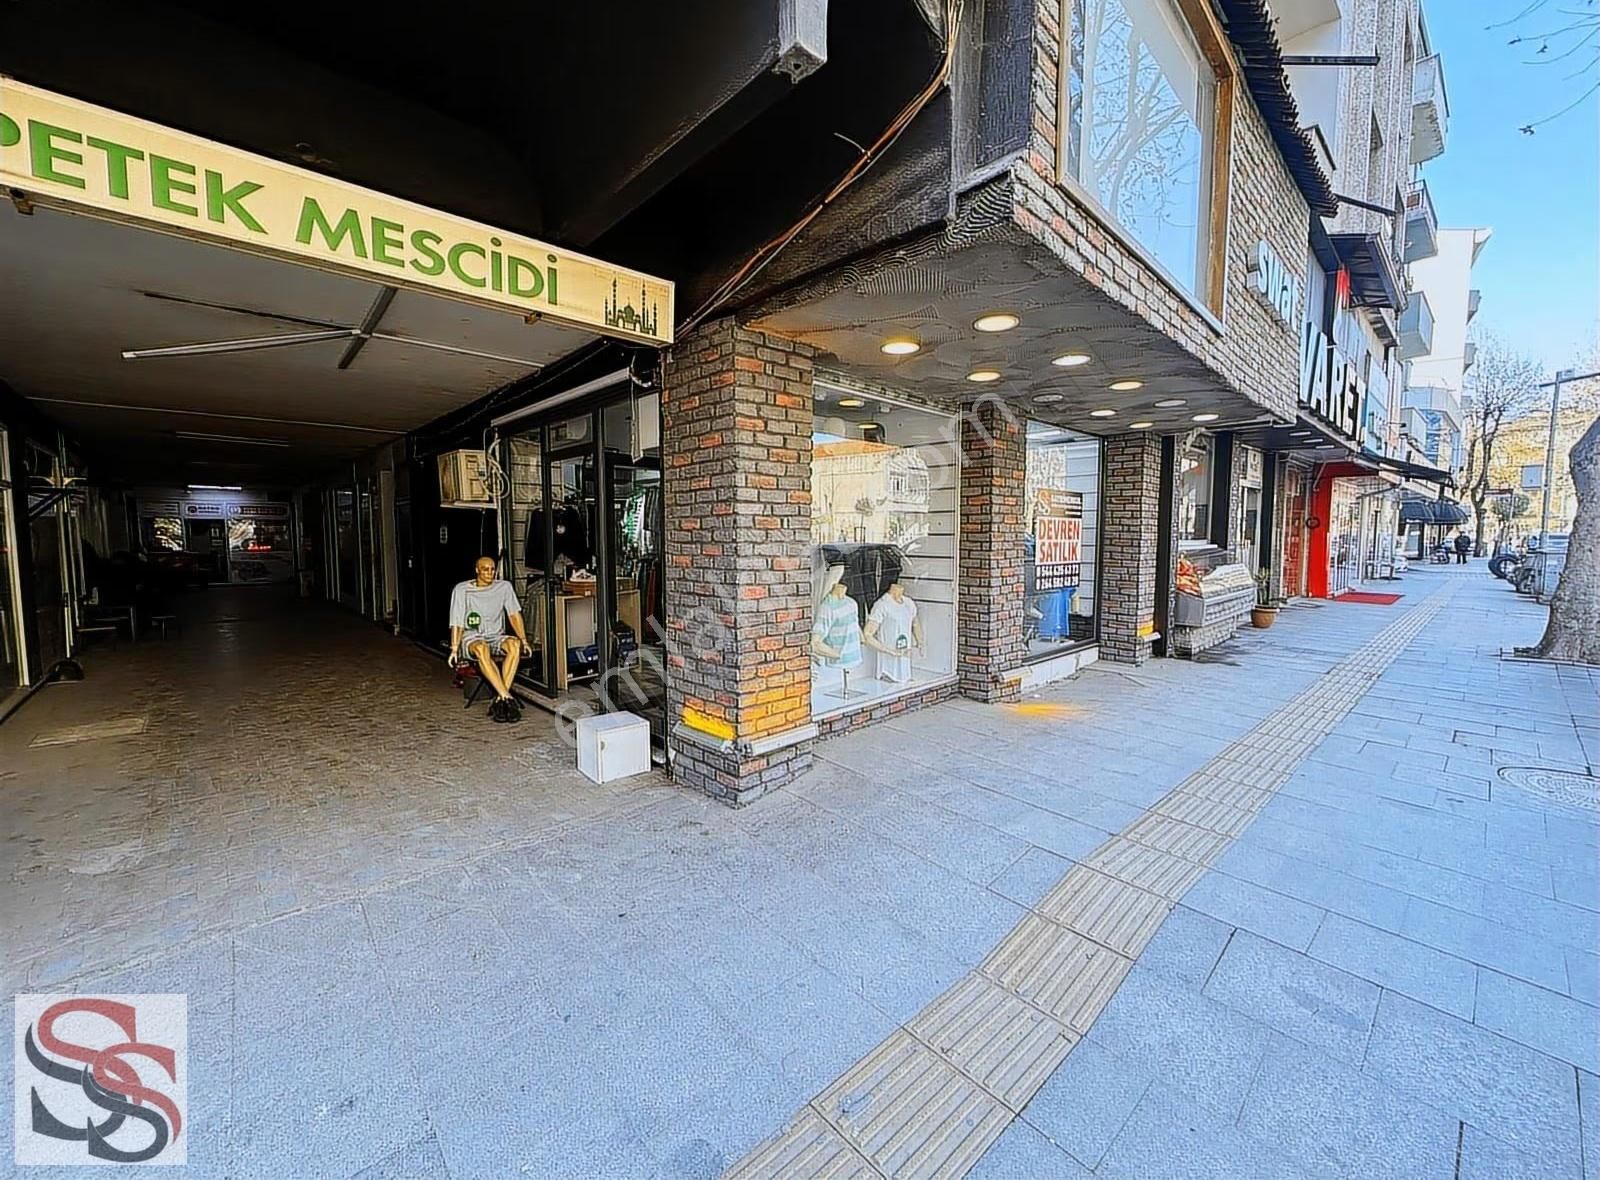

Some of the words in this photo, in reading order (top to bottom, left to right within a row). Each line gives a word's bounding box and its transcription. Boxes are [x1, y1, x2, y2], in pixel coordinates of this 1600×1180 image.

[295, 197, 559, 306] MESCİDİ
[1038, 518, 1081, 541] DEVREN
[1039, 540, 1079, 564] SATILIK
